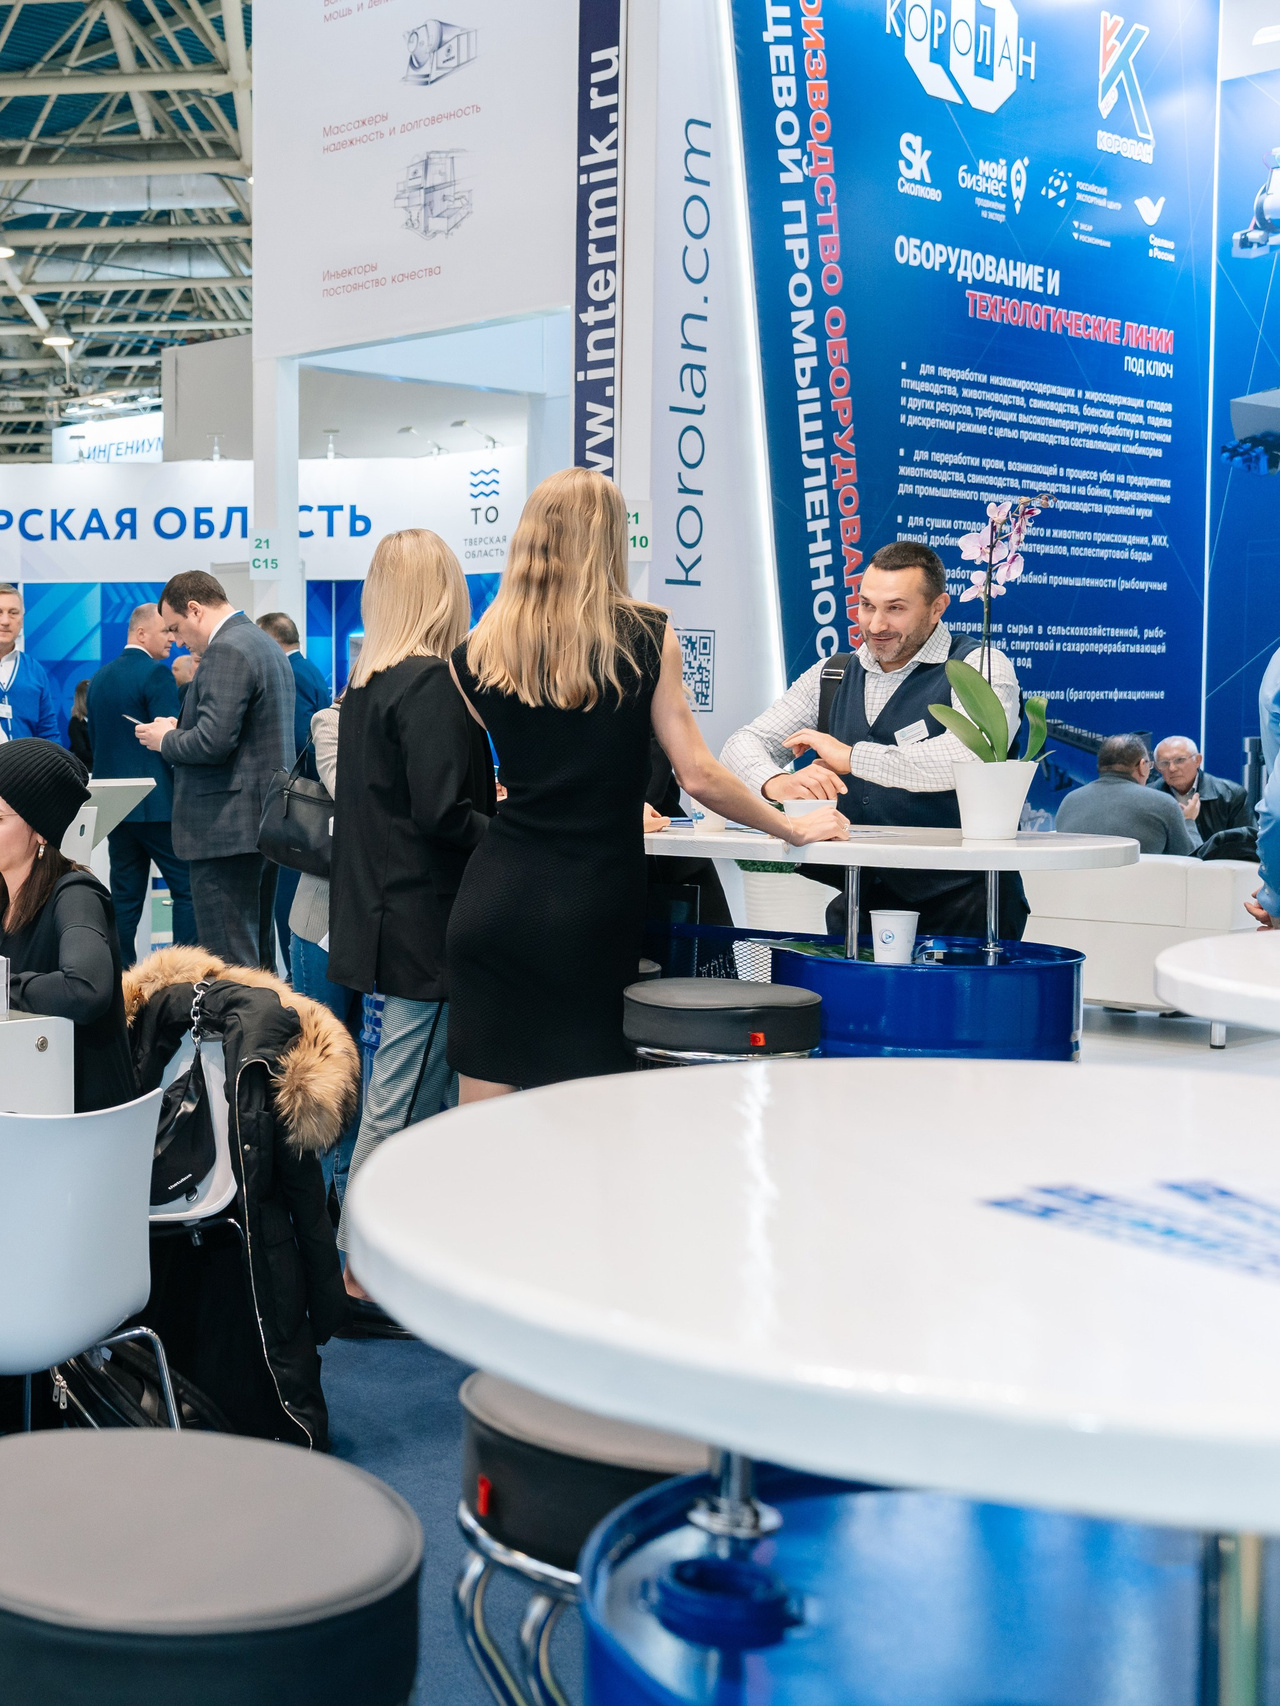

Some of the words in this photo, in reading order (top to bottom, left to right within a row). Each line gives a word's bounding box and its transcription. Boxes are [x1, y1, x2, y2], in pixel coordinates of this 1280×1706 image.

[885, 0, 1036, 81] КОРОЛАН
[322, 112, 389, 138] Массажеры
[322, 132, 385, 154] надежность
[388, 127, 396, 136] и
[400, 104, 482, 134] долговечность
[898, 132, 932, 183] Sk
[978, 158, 1007, 181] мой
[897, 177, 942, 202] Сколково
[958, 165, 1007, 198] бизнес
[322, 262, 378, 282] Инъекторы
[322, 277, 387, 298] постоянство
[391, 265, 442, 284] качества
[894, 234, 1044, 293] ОБОРУДОВАНИЕ
[1047, 269, 1060, 296] И
[965, 289, 1121, 346] ТЕХНОЛОГИЧЕСКИЕ
[1122, 321, 1175, 355] ЛИНИИ
[665, 118, 712, 587] korolan.com
[1124, 356, 1145, 377] ПОД
[1146, 359, 1174, 379] КЛЮЧ
[901, 378, 959, 398] птицеводства,
[962, 388, 1026, 408] животноводства,
[1029, 398, 1080, 416] свиноводства,
[1083, 404, 1114, 419] боенских
[1117, 411, 1145, 425] отходов,
[1147, 415, 1172, 428] падежа
[920, 363, 935, 376] для
[938, 366, 987, 384] переработки
[990, 375, 1075, 398] низкожиросодержащих
[1085, 390, 1144, 409] жиросодержащих
[1146, 400, 1172, 412] отходов
[901, 396, 906, 406] и
[907, 397, 935, 411] других
[936, 401, 973, 417] ресурсов,
[975, 405, 1017, 423] требующих
[1019, 413, 1099, 435] высокотемпературную
[1100, 423, 1134, 440] обработку
[1140, 430, 1171, 443] поточном
[900, 414, 906, 424] и
[907, 415, 955, 430] дискретном
[956, 422, 987, 434] режиме
[994, 427, 1019, 439] целью
[1020, 430, 1069, 446] производства
[1071, 436, 1121, 453] составляющих
[1122, 443, 1162, 459] комбикорма
[825, 306, 864, 654] ОБОРУДОВАНИ
[898, 465, 966, 484] животноводства,
[967, 473, 1020, 490] свиноводства,
[1022, 479, 1070, 495] птицеводства
[1078, 485, 1086, 495] на
[1087, 484, 1112, 499] бойнях,
[1113, 489, 1171, 504] предназначенные
[914, 450, 929, 461] для
[931, 451, 980, 467] переработки
[982, 458, 1005, 471] крови,
[1008, 461, 1057, 477] возникающей
[1066, 468, 1098, 481] процессе
[1099, 469, 1115, 484] убоя
[1116, 474, 1124, 483] на
[1126, 474, 1171, 489] предприятиях
[470, 506, 499, 525] ТО
[898, 483, 913, 495] для
[915, 484, 978, 501] промышленного
[980, 491, 1024, 505] применени
[1055, 500, 1103, 512] производства
[1104, 505, 1135, 517] кровяной
[1136, 507, 1152, 519] муки
[153, 504, 372, 540] ОБЛСТЬ
[627, 512, 639, 525] 1
[908, 515, 924, 527] для
[925, 518, 952, 530] сушки
[1046, 528, 1051, 538] и
[1052, 528, 1092, 541] животного
[1093, 532, 1150, 546] происхождения,
[1151, 534, 1169, 548] ЖКХ,
[254, 538, 270, 549] 21
[464, 535, 507, 547] ТВЕРСКАЯ
[464, 548, 505, 559] ОБЛАСТЬ
[1070, 545, 1129, 560] послеспиртовой
[1130, 548, 1153, 562] барды
[252, 558, 278, 570] C15
[1049, 574, 1116, 588] промышленности
[1118, 576, 1167, 592] (рыбомучные
[944, 621, 1003, 634] выпаривия
[1007, 624, 1034, 636] сырья
[1038, 625, 1043, 634] в
[1047, 625, 1140, 639] сельскохозяйственной,
[1144, 626, 1166, 640] рыбо-
[1011, 639, 1054, 653] спиртовой
[1056, 642, 1061, 651] и
[1062, 641, 1166, 655] сахароперерабатывающей
[1016, 657, 1032, 669] вод
[1021, 687, 1065, 700] иоэтанола
[1066, 687, 1165, 702] (брагоректификационные
